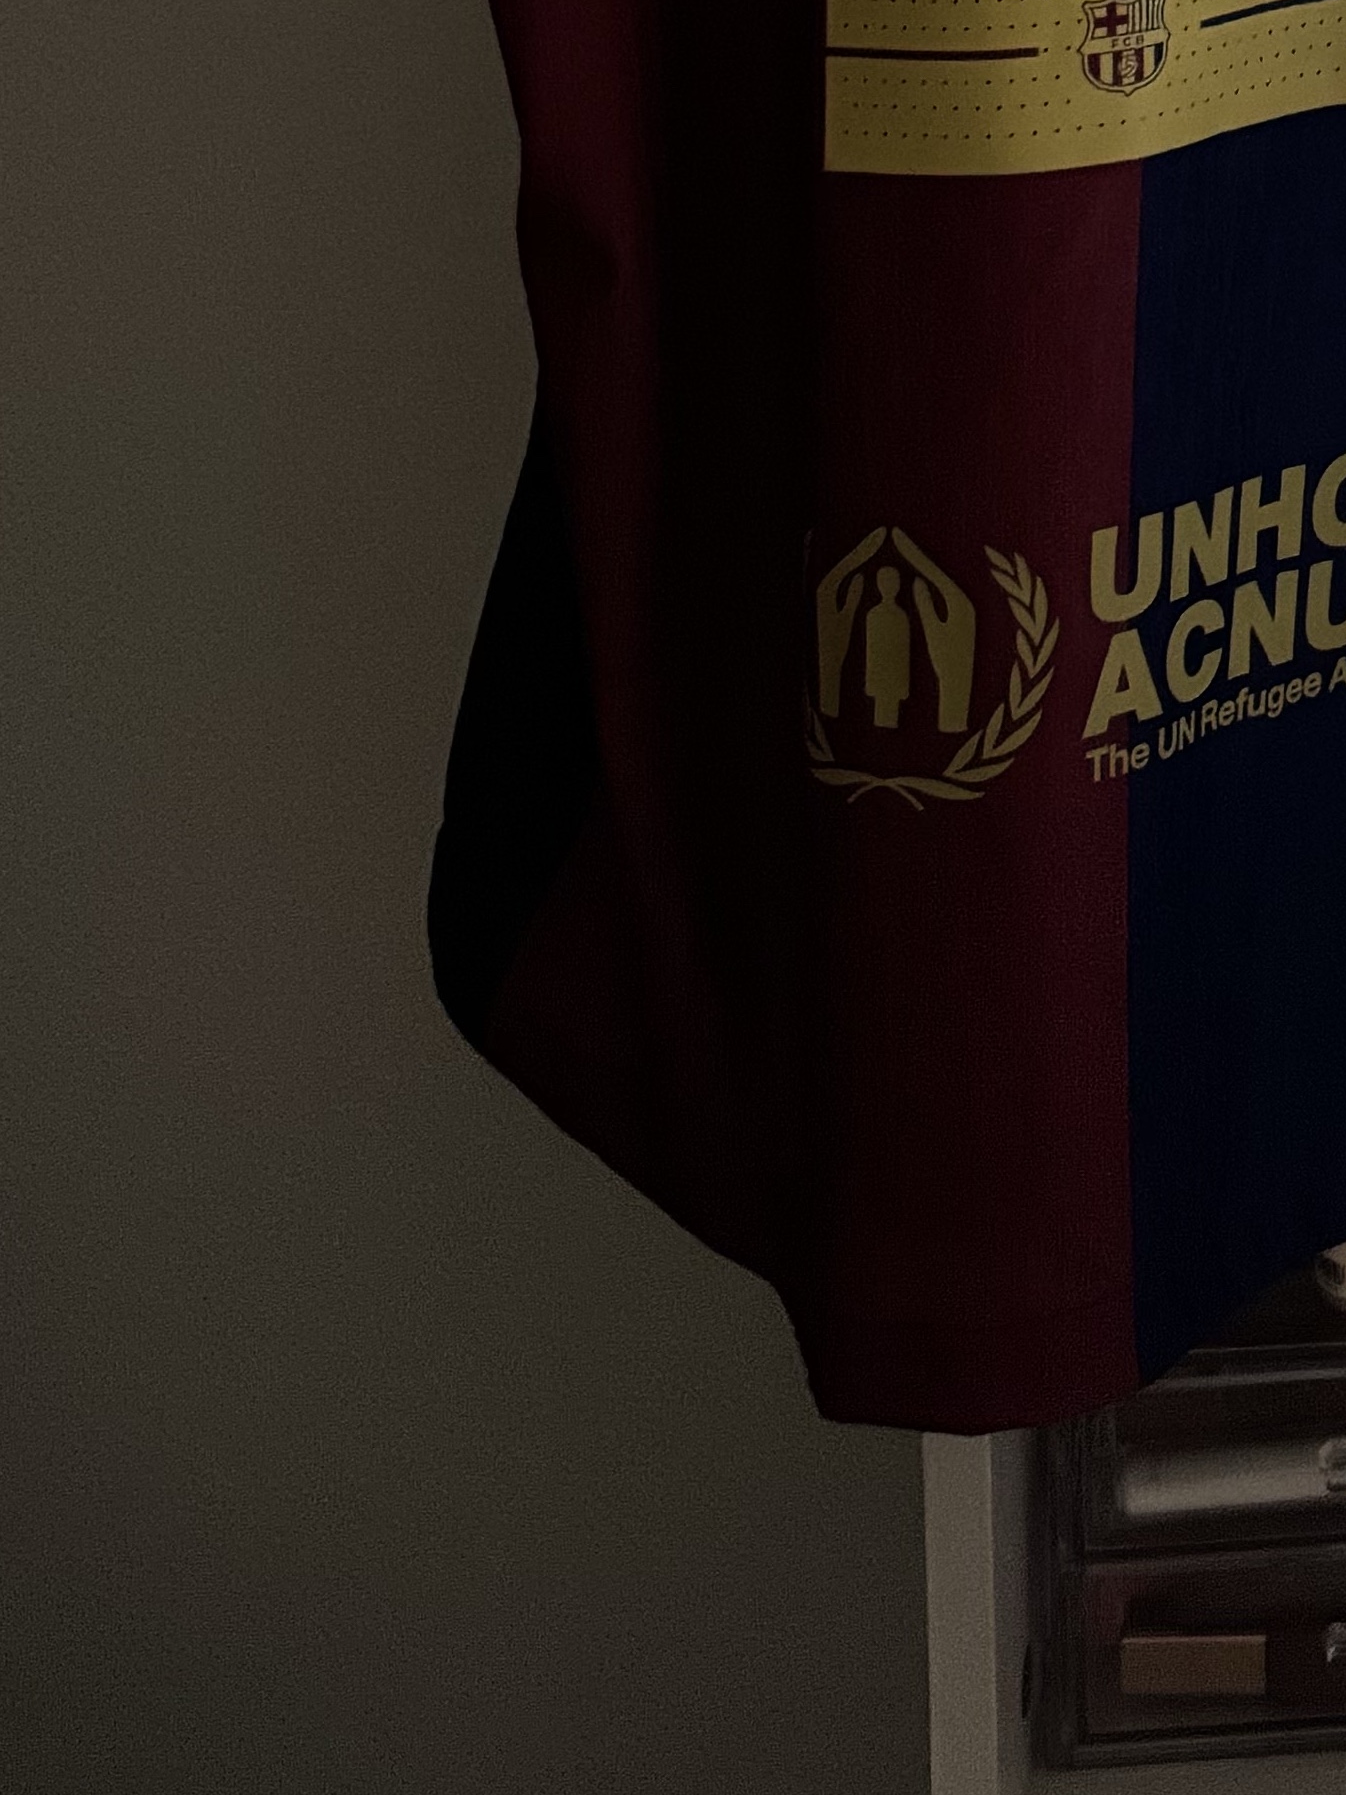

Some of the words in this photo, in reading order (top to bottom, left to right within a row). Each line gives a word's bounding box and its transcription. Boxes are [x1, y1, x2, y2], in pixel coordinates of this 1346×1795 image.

[1085, 742, 1150, 783] The
[1157, 711, 1197, 760] UN
[1200, 671, 1323, 737] Refugee
